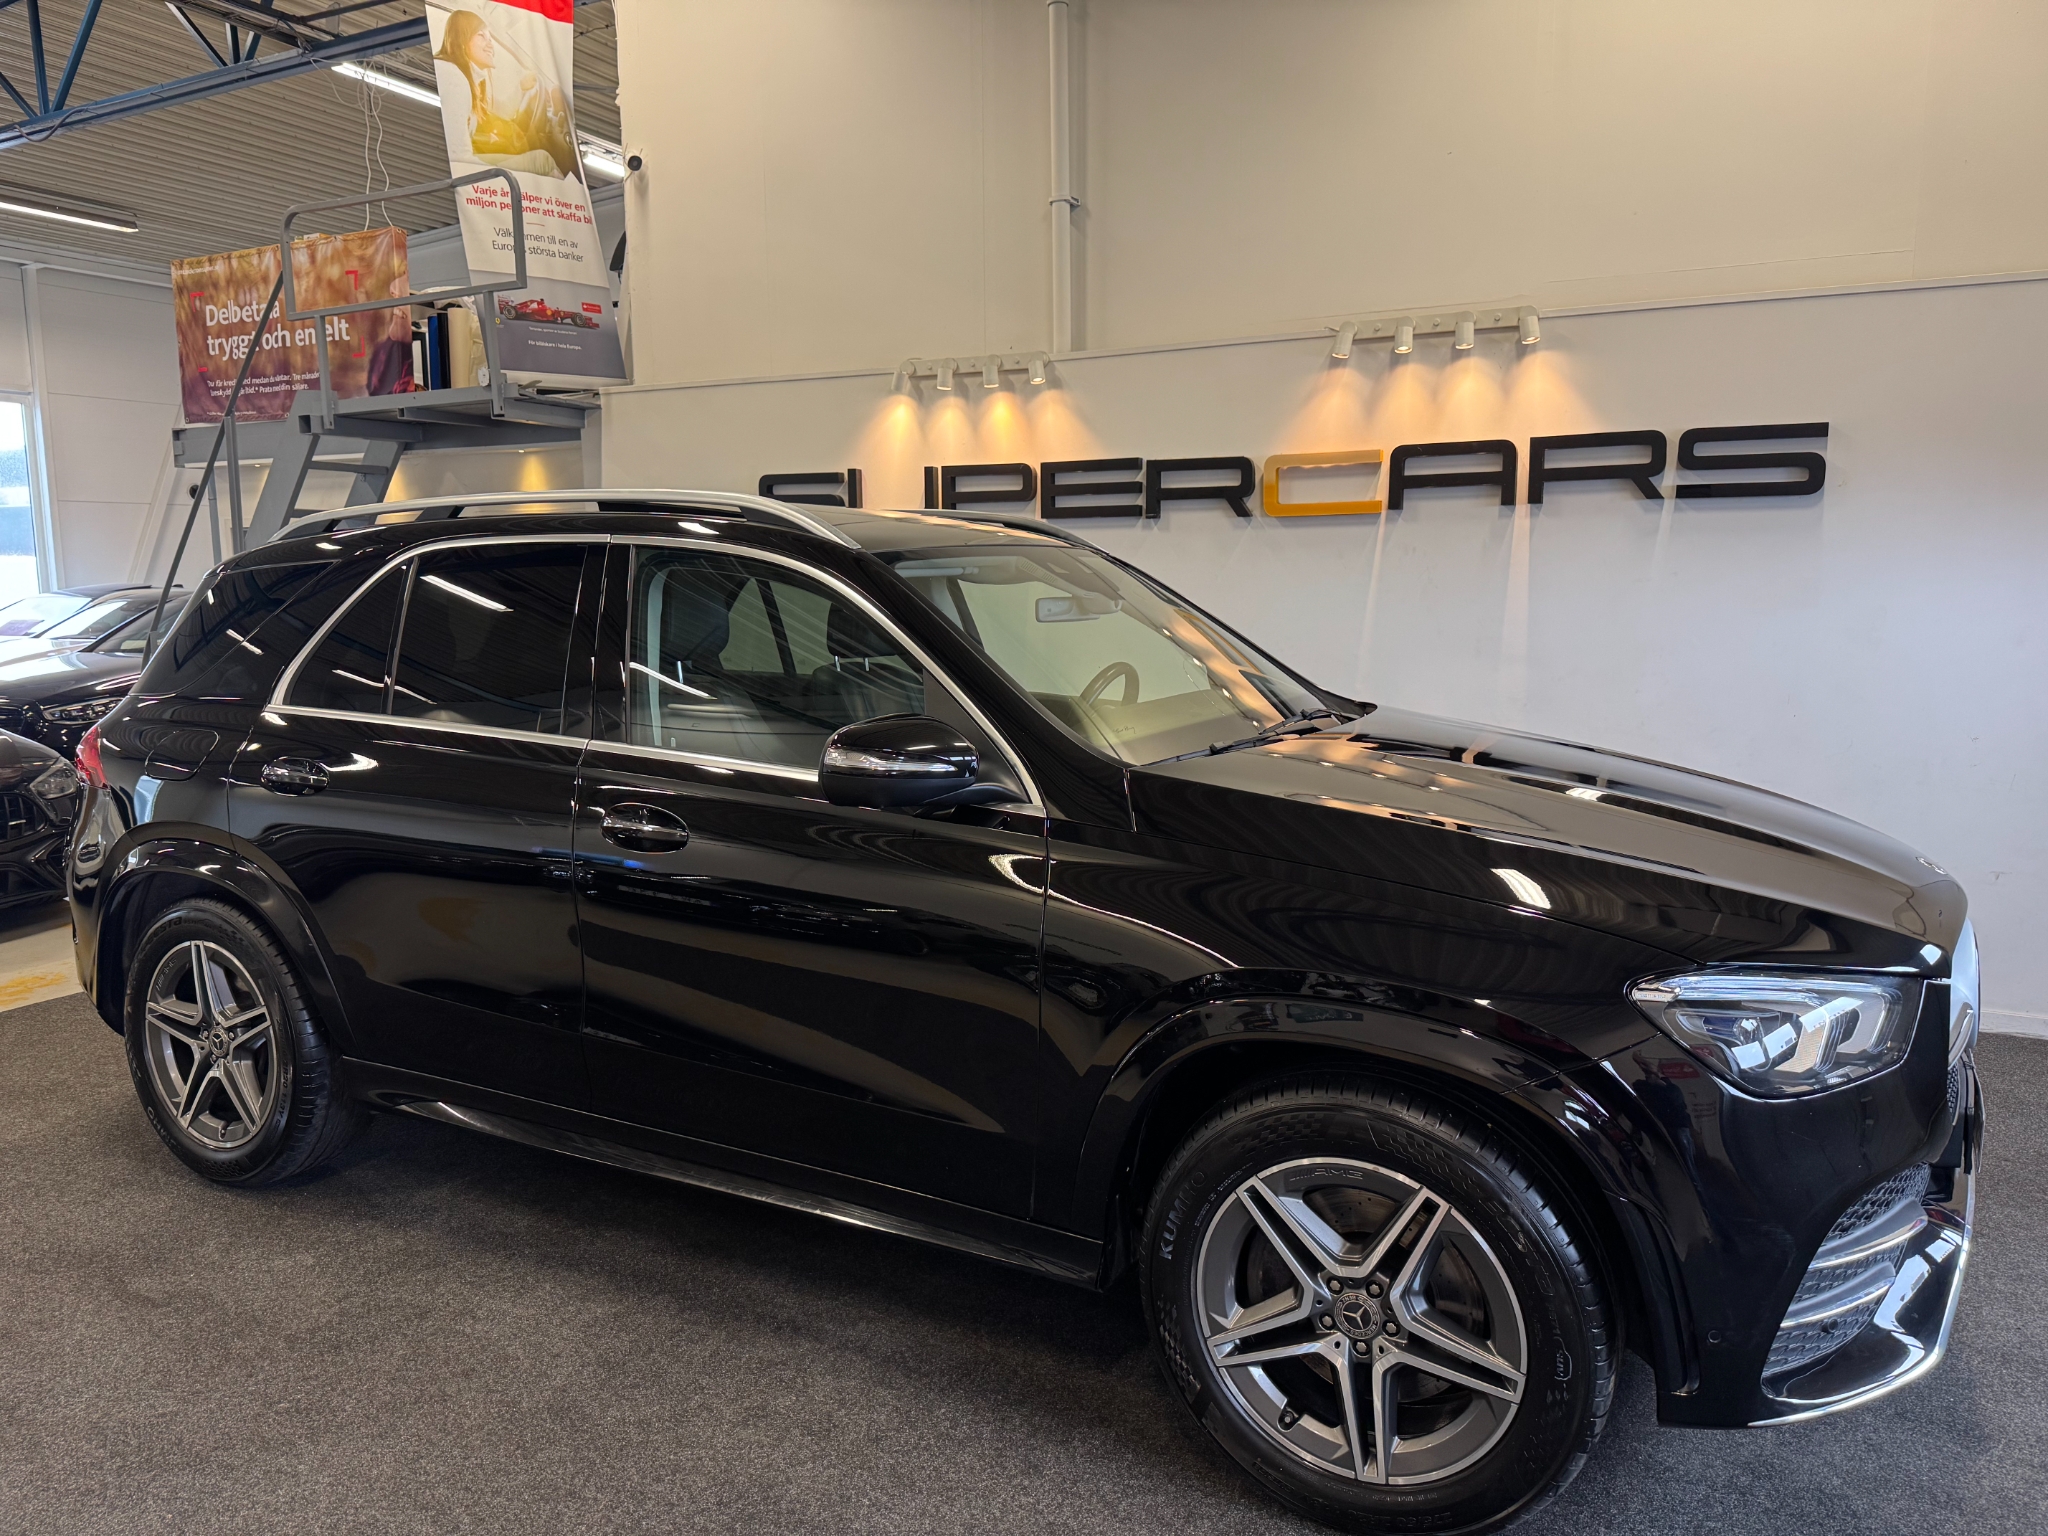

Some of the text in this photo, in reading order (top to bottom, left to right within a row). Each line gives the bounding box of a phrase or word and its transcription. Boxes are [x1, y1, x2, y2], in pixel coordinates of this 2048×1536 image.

[466, 196, 498, 210] miljon
[500, 201, 540, 215] peoner
[542, 208, 555, 218] att
[557, 210, 582, 223] skaffa
[472, 185, 498, 198] Varje
[500, 187, 510, 198] år
[544, 197, 553, 206] vi
[555, 198, 573, 210] över
[574, 204, 586, 212] en
[492, 240, 584, 262] Euro största banker
[493, 227, 579, 249] Välkmen till en av
[205, 299, 280, 327] Delbetaa
[262, 323, 291, 350] och
[295, 316, 351, 346] enelt
[293, 373, 301, 381] Tre
[758, 422, 1829, 518] SUPERCARS
